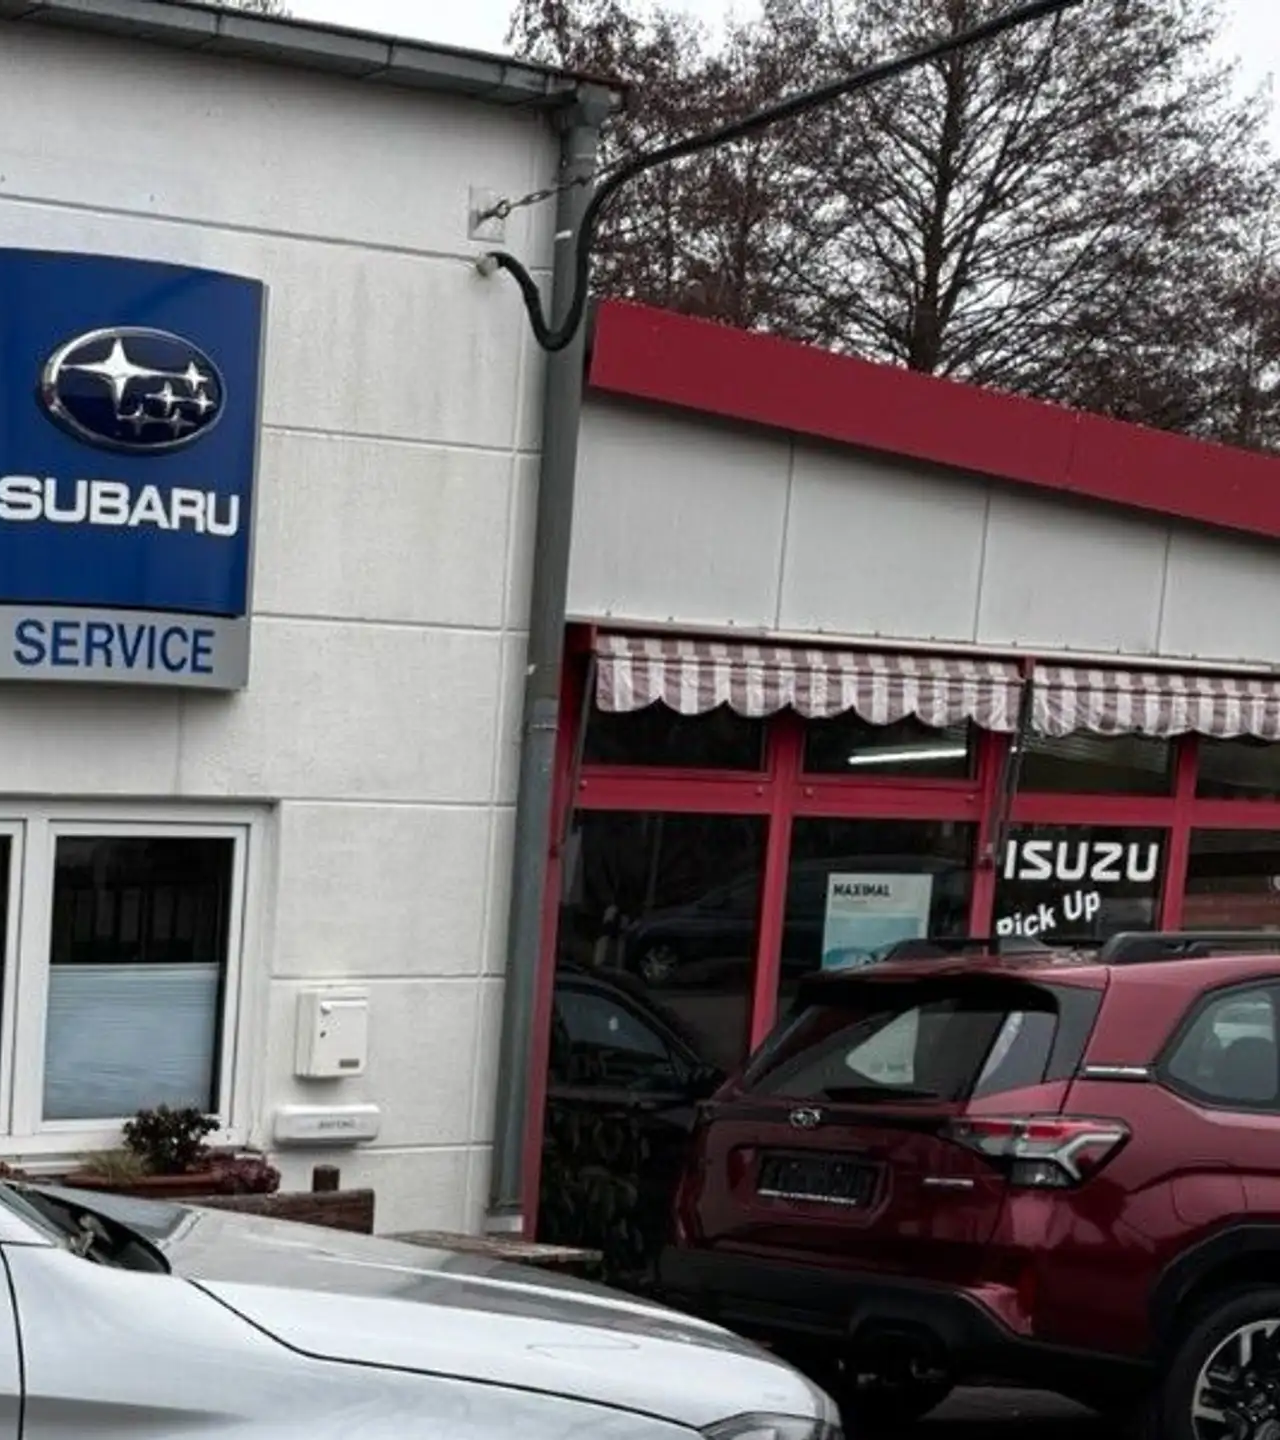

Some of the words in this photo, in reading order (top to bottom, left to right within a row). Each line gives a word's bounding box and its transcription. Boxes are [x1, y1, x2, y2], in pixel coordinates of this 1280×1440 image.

[13, 618, 215, 675] SERVICE
[1003, 839, 1160, 883] ISUZU
[833, 883, 891, 898] MAXIMAL
